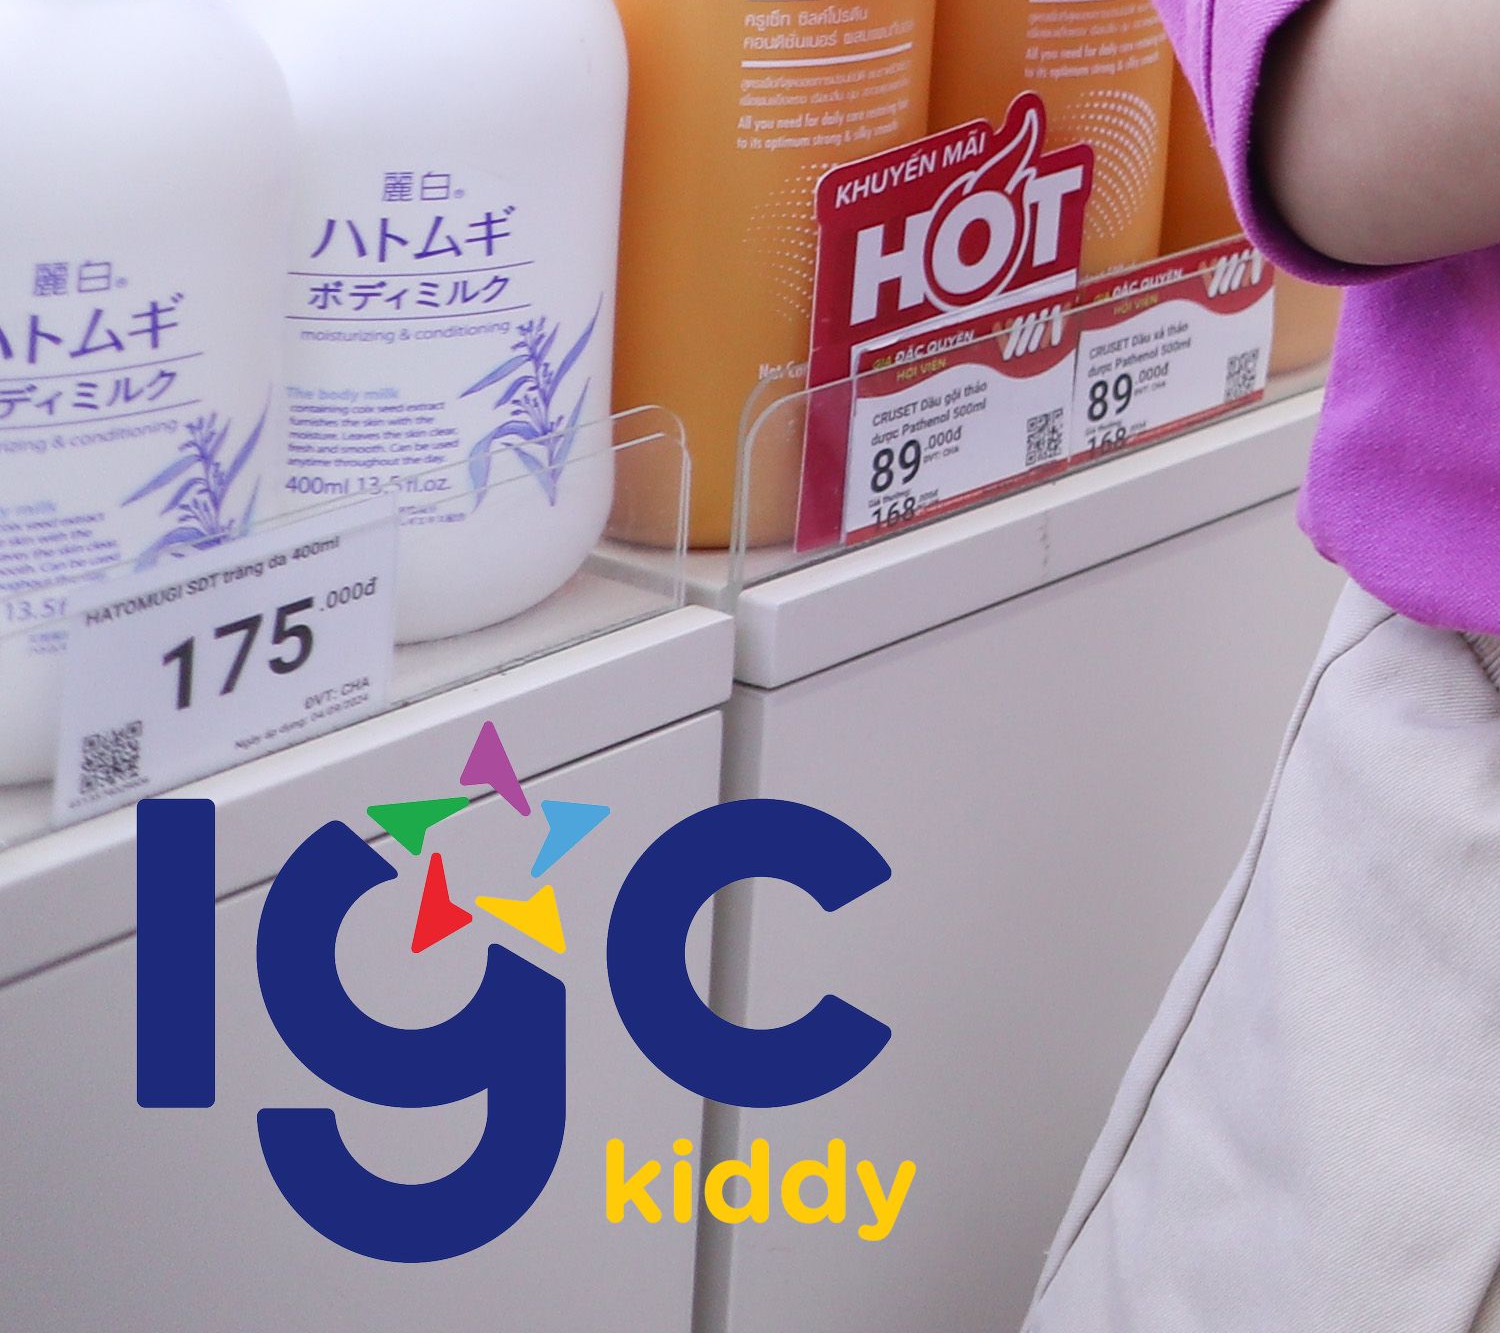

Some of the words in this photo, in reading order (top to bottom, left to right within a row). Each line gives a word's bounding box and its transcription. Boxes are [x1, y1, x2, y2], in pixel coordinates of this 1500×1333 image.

[834, 144, 937, 210] KHUYẾN
[941, 129, 988, 169] MÃI
[310, 204, 517, 264] ハトムギ
[850, 163, 1085, 327] HOT
[308, 274, 511, 312] ボディミルク
[299, 326, 396, 345] moisturizing
[399, 327, 411, 342] &
[414, 319, 512, 343] conditioning
[1088, 336, 1130, 361] CRUSET
[1114, 345, 1160, 374] Pathenol
[1160, 336, 1192, 358] 500ml
[286, 386, 317, 400] The
[317, 386, 360, 404] body
[361, 385, 400, 401] milk
[871, 401, 919, 428] CRUSET
[919, 393, 944, 412] Dầu
[944, 386, 964, 407] gội
[1086, 372, 1134, 423] 89
[1135, 361, 1170, 384] .000đ
[69, 418, 179, 447] conditioning
[901, 408, 952, 438] Pathenol
[952, 398, 988, 419] 500ml
[869, 437, 922, 494] 89
[923, 424, 964, 452] .000đ
[1086, 426, 1128, 455] 168
[284, 476, 350, 495] 400ml
[871, 495, 918, 530] 168
[85, 584, 184, 627] HATOMUGI
[185, 573, 218, 597] SDT
[268, 553, 288, 569] da
[290, 535, 342, 561] 400ml
[161, 596, 315, 711] 175
[318, 576, 379, 613] .000đ
[303, 688, 338, 710] ĐVT:
[340, 675, 371, 698] CHA
